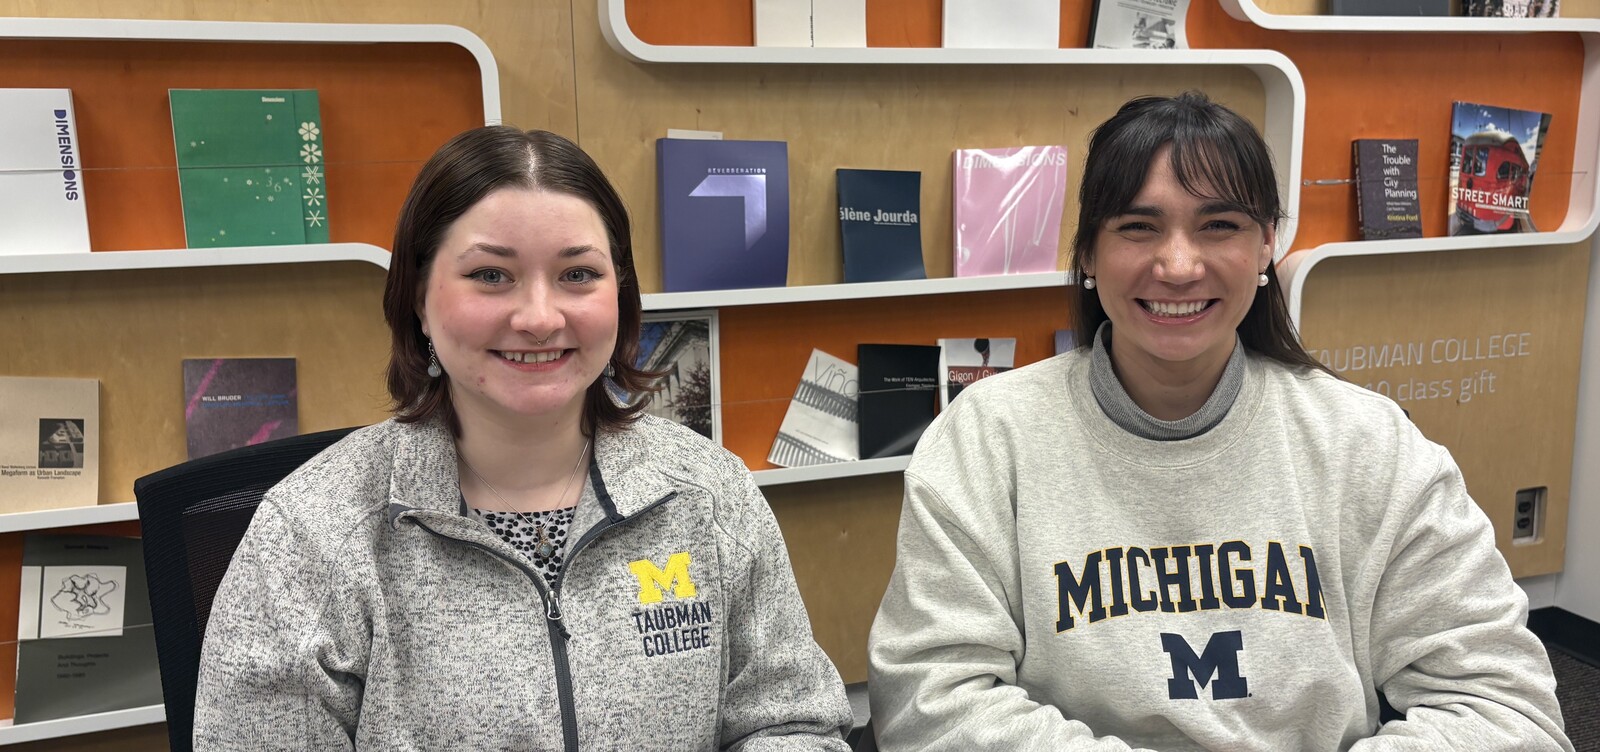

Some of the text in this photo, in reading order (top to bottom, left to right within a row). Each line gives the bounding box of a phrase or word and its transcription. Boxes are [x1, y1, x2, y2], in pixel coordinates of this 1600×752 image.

[54, 109, 79, 201] DIMENSIONS
[1382, 143, 1397, 154] The
[963, 152, 1065, 169] DIMSIONS
[1382, 155, 1411, 165] Trouble
[1383, 166, 1400, 176] with
[1383, 177, 1399, 189] City
[1385, 188, 1417, 200] Planning
[1451, 187, 1529, 209] STREET SMART
[873, 209, 918, 223] Jourda
[1431, 333, 1532, 364] COLLEGE
[948, 370, 974, 384] Gigon
[1397, 377, 1453, 401] class
[1459, 369, 1497, 403] gift
[54, 469, 81, 477] Landscape
[628, 551, 697, 605] M
[632, 601, 712, 634] TAUBMAN
[643, 626, 711, 657] COLLEGE
[1159, 630, 1249, 701] M
